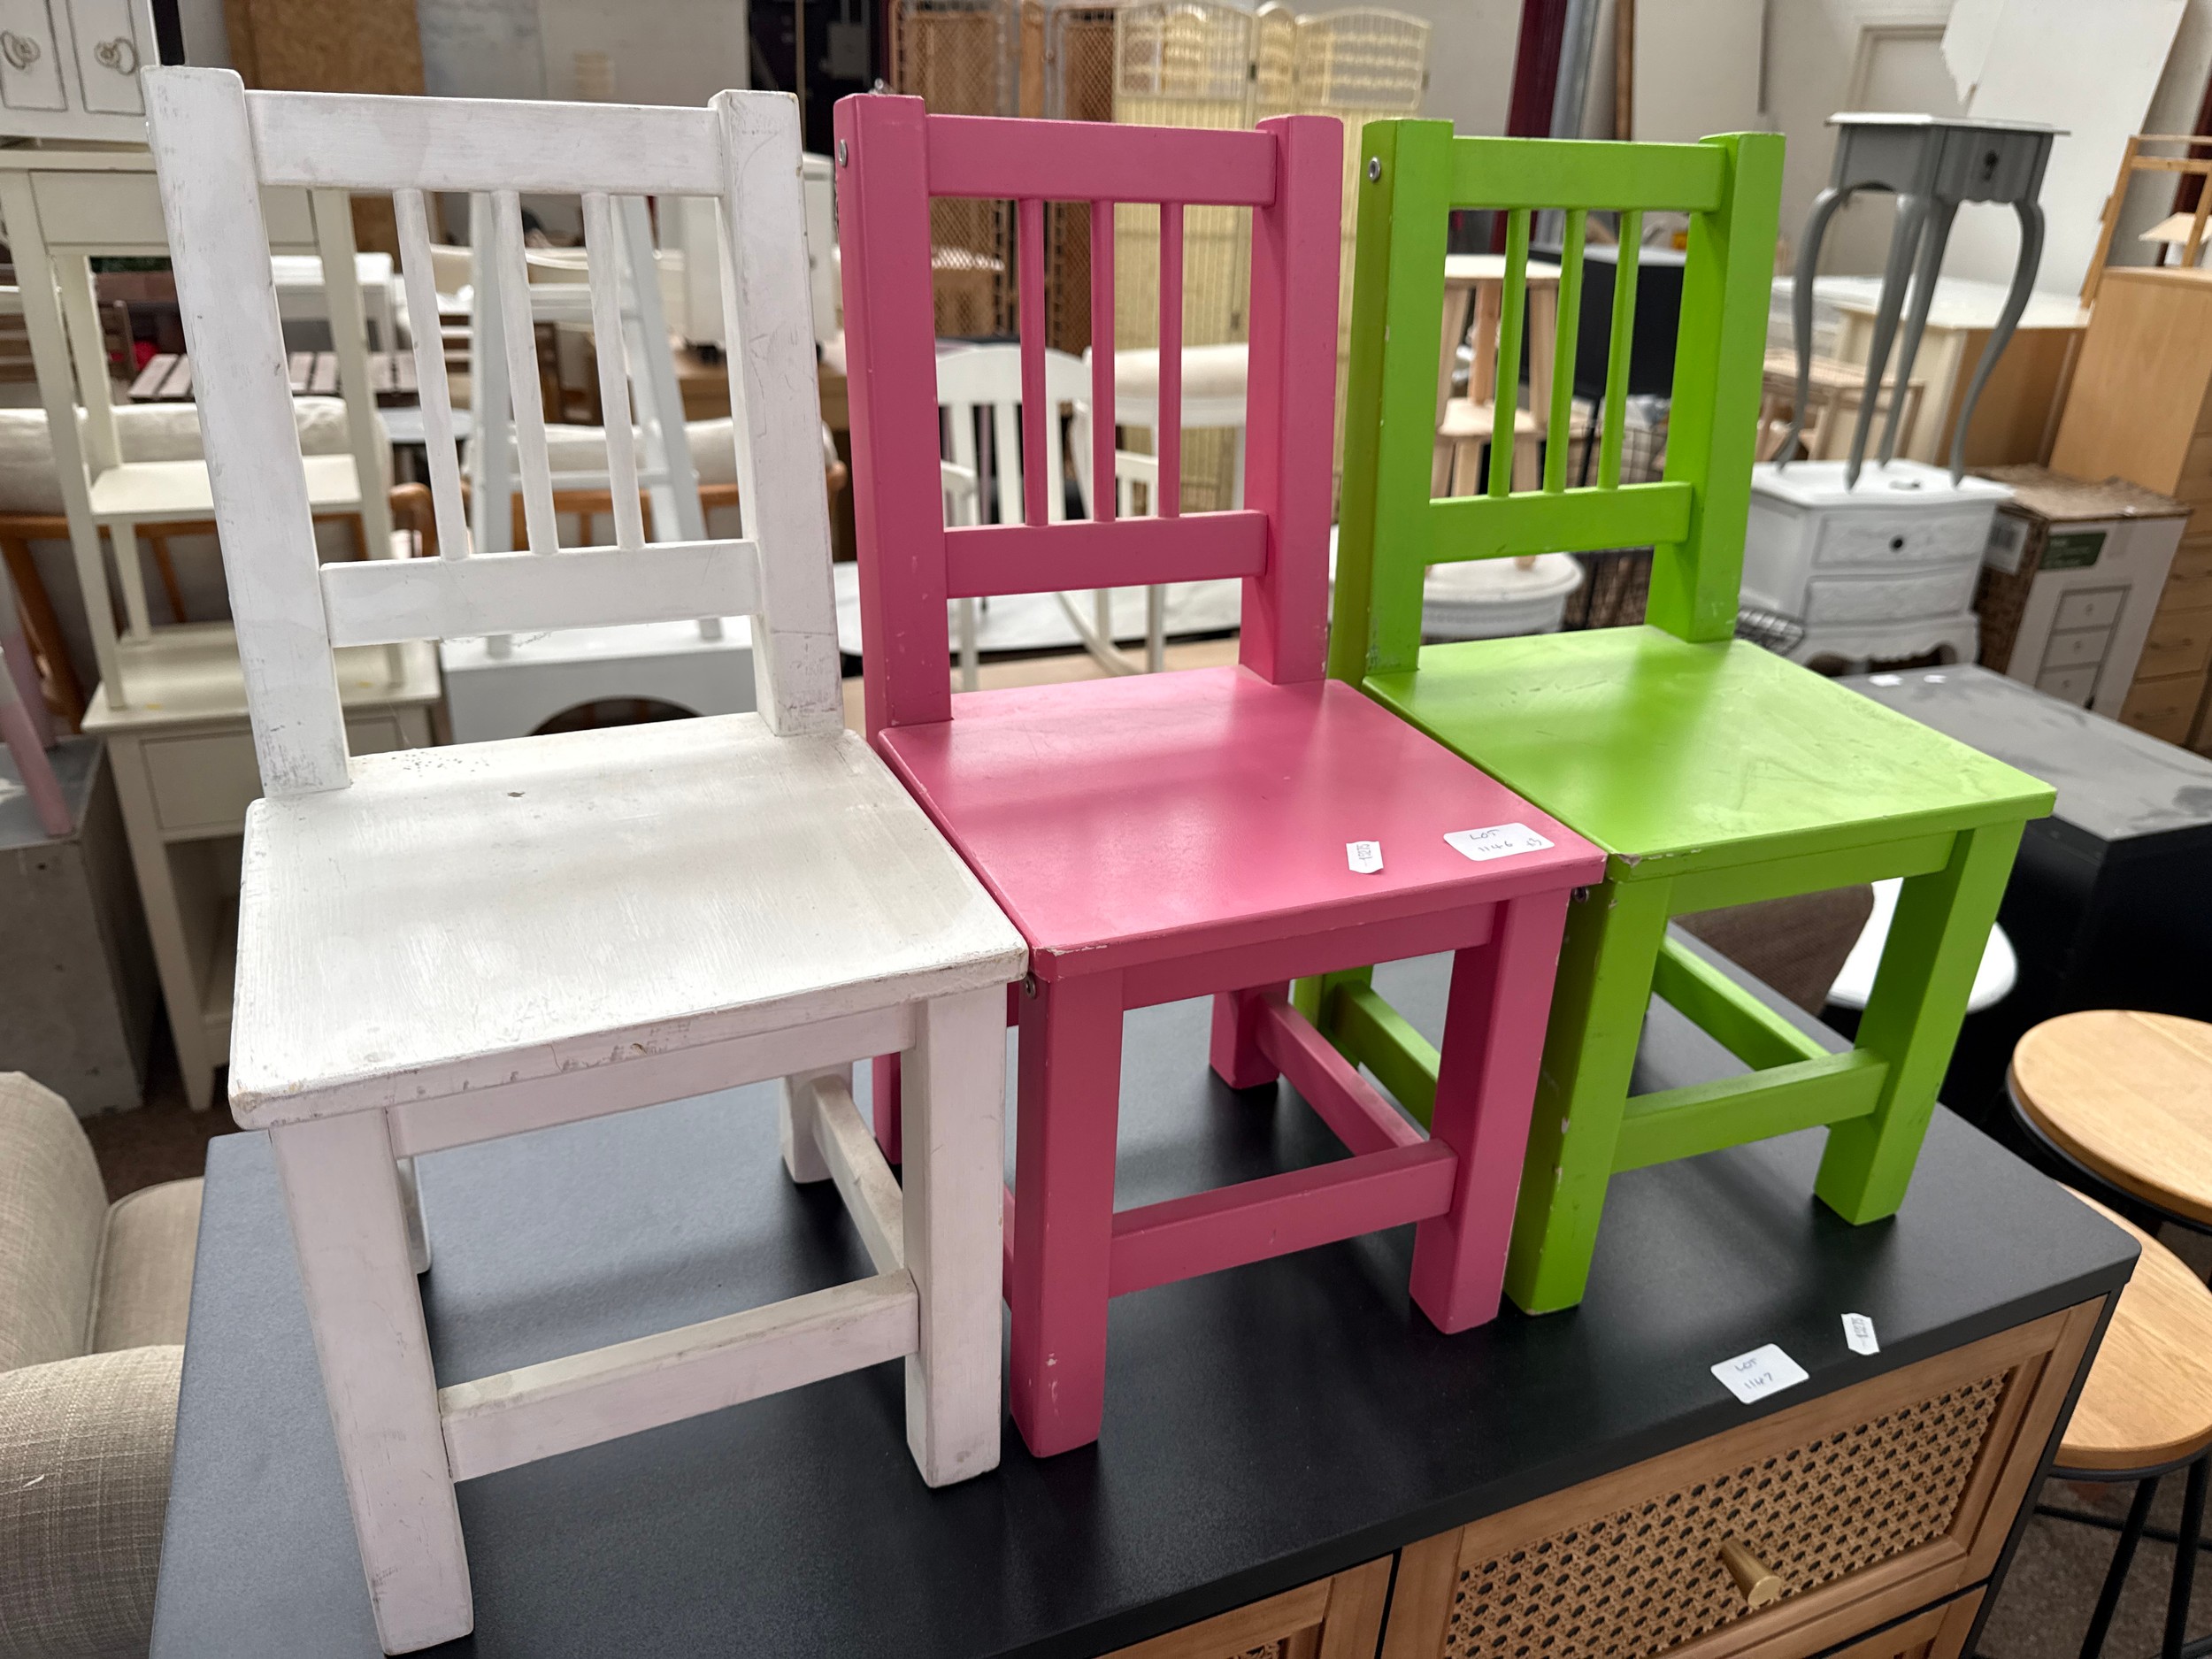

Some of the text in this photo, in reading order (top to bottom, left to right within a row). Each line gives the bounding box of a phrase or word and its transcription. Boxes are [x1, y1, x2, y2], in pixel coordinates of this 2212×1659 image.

[1470, 828, 1500, 841] LOT
[1478, 840, 1513, 852] 1146
[1734, 1357, 1757, 1372] LOT
